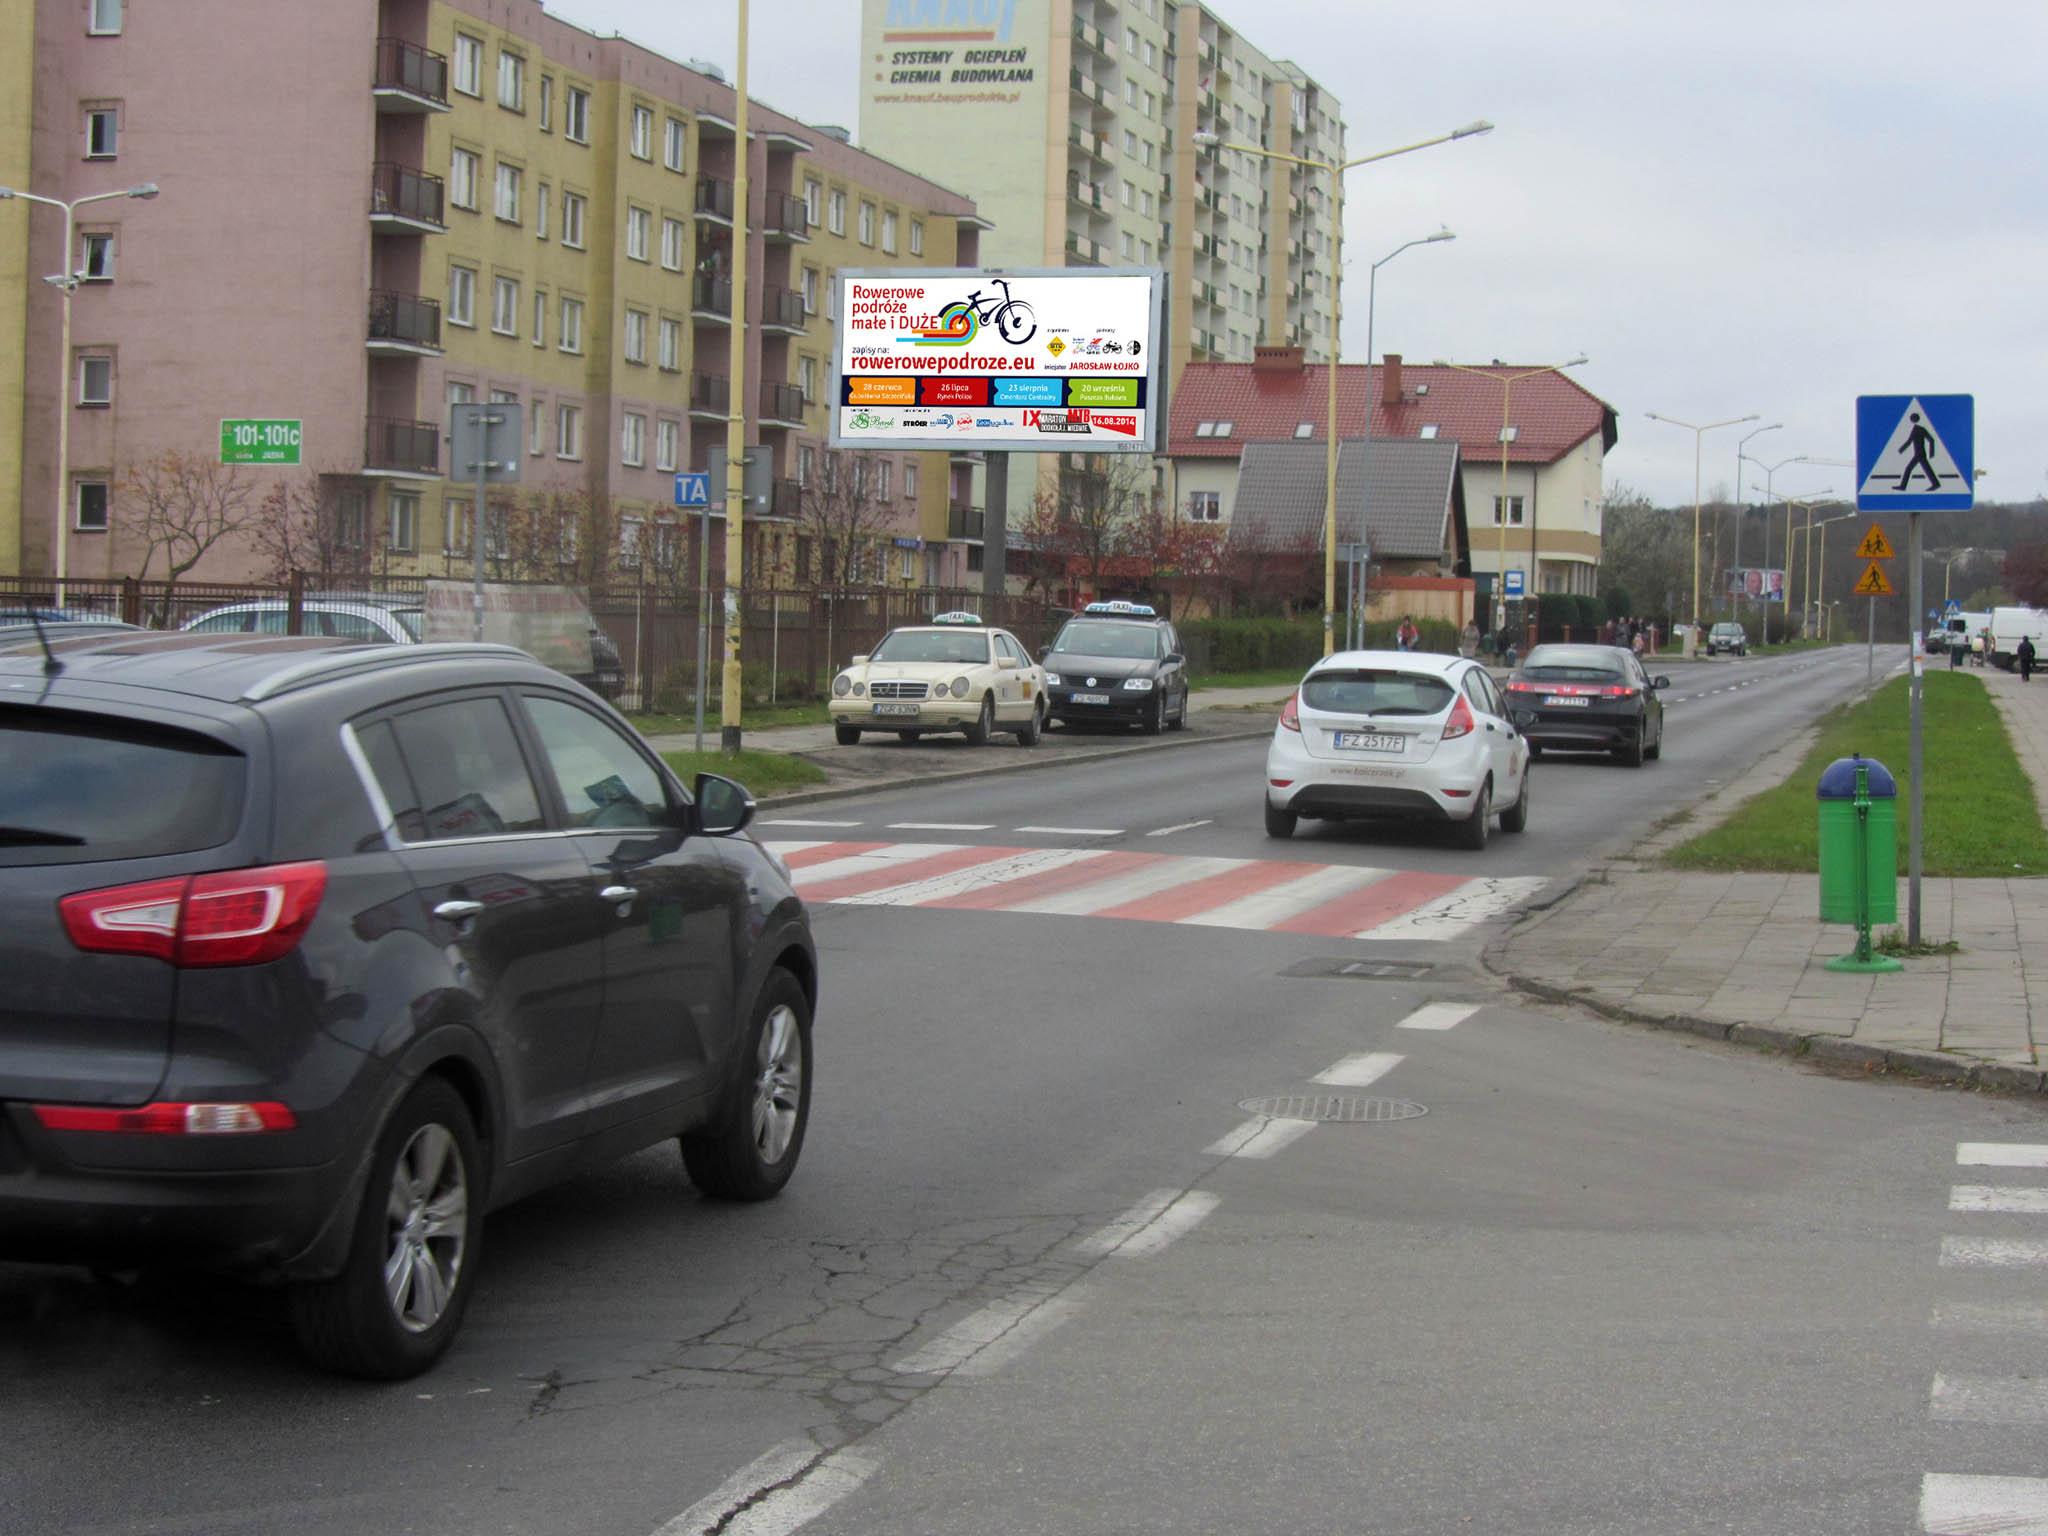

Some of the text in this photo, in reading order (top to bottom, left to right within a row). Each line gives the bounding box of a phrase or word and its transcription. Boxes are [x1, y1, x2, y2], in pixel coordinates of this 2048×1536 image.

[892, 47, 1027, 65] SYSTEMY OCIEPLEŃ
[890, 68, 1034, 84] CHEMIA BUDOWLANA
[853, 284, 925, 299] Rowerowe
[852, 299, 907, 317] podróże
[851, 312, 938, 330] małe i DUŻE
[852, 345, 890, 355] zapisy na:
[851, 351, 1035, 374] rowerowepodroze.eu
[1068, 362, 1112, 370] JAROSŁAW
[1113, 362, 1140, 371] ŁOJKO
[863, 383, 872, 391] 28
[951, 384, 969, 393] lipca
[1008, 384, 1048, 393] 23 sierpnia
[1081, 384, 1125, 393] 20 września
[1023, 409, 1041, 427] IX
[1040, 414, 1067, 424] MARATON
[1067, 408, 1091, 423] MTB
[1093, 416, 1136, 426] 16.08.2014
[233, 424, 300, 446] 101-101c
[677, 478, 707, 502] TA
[1112, 602, 1130, 610] TAXI
[1342, 734, 1402, 748] FZ 2517F
